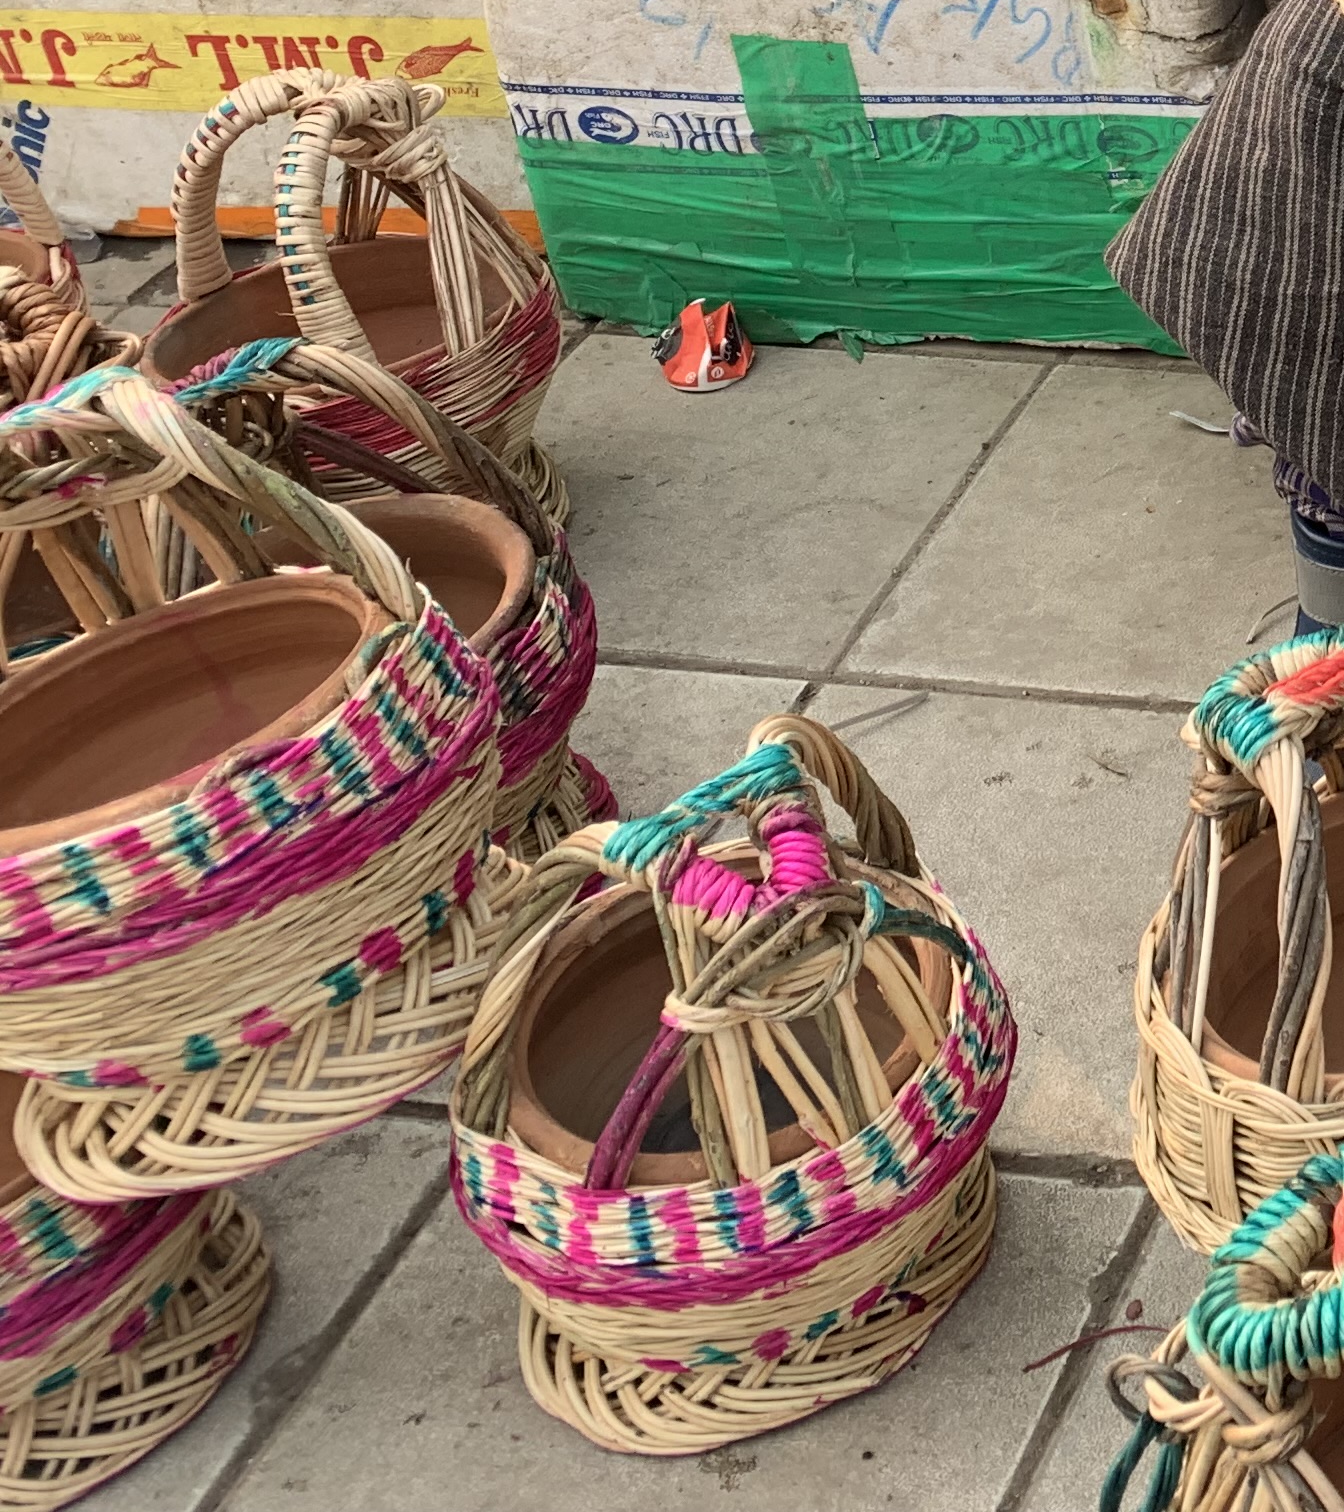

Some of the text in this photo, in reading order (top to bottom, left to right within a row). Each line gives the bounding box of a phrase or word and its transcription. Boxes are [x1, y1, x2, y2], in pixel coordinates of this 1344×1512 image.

[1121, 95, 1140, 103] DRC
[647, 130, 670, 139] FISH
[653, 111, 747, 157] DRC
